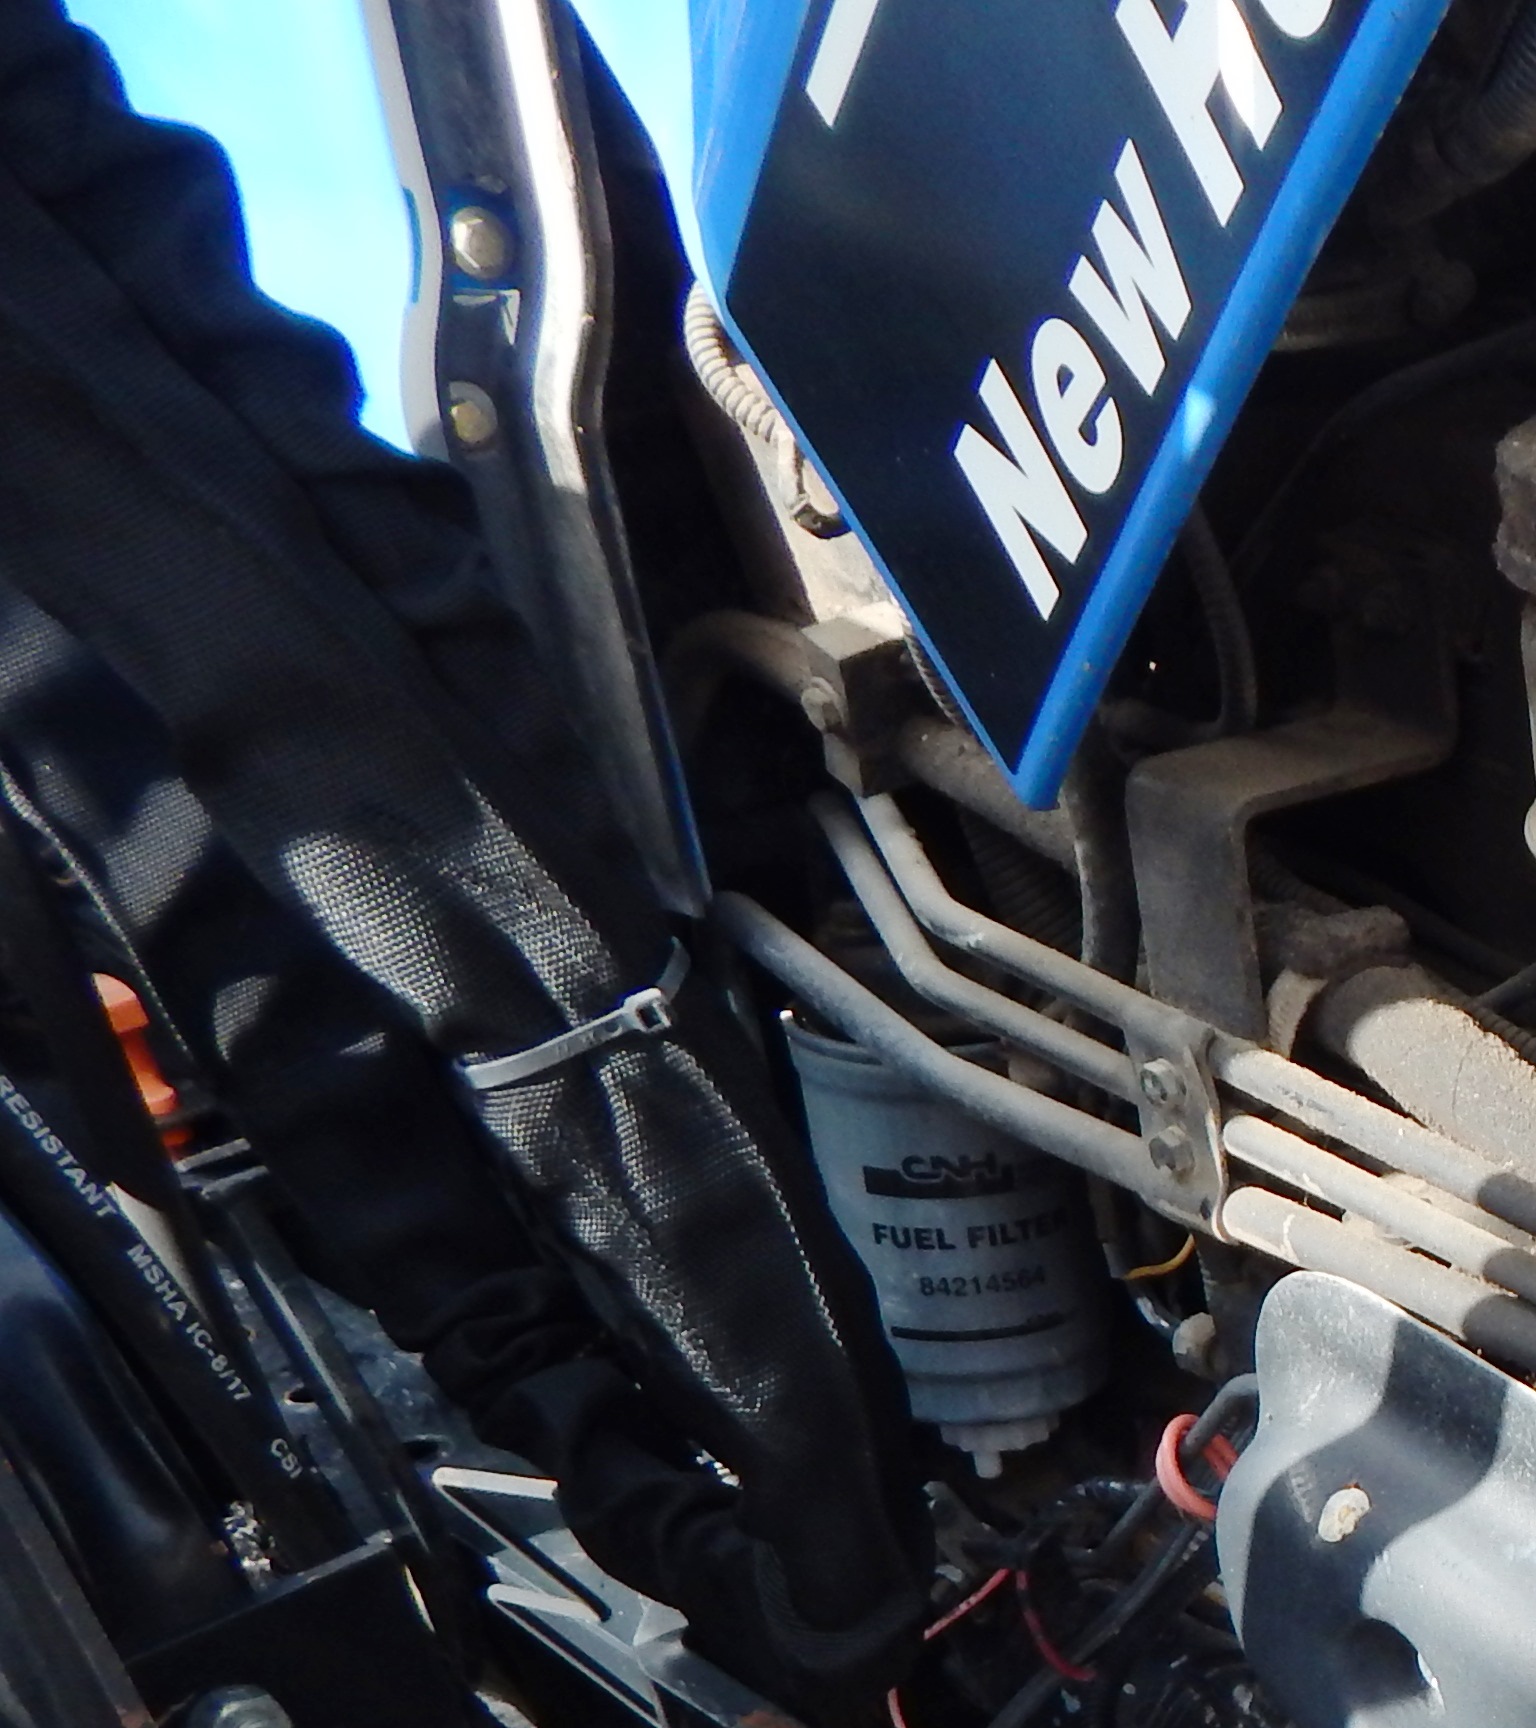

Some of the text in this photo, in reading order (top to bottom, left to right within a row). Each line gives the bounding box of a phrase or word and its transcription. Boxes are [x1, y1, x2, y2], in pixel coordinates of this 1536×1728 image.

[953, 138, 1192, 622] New
[0, 1075, 302, 1479] RESISTANT MSHA IC-8/17 CSI
[872, 1207, 1068, 1251] FUEL FILTER
[902, 1152, 999, 1181] CNH
